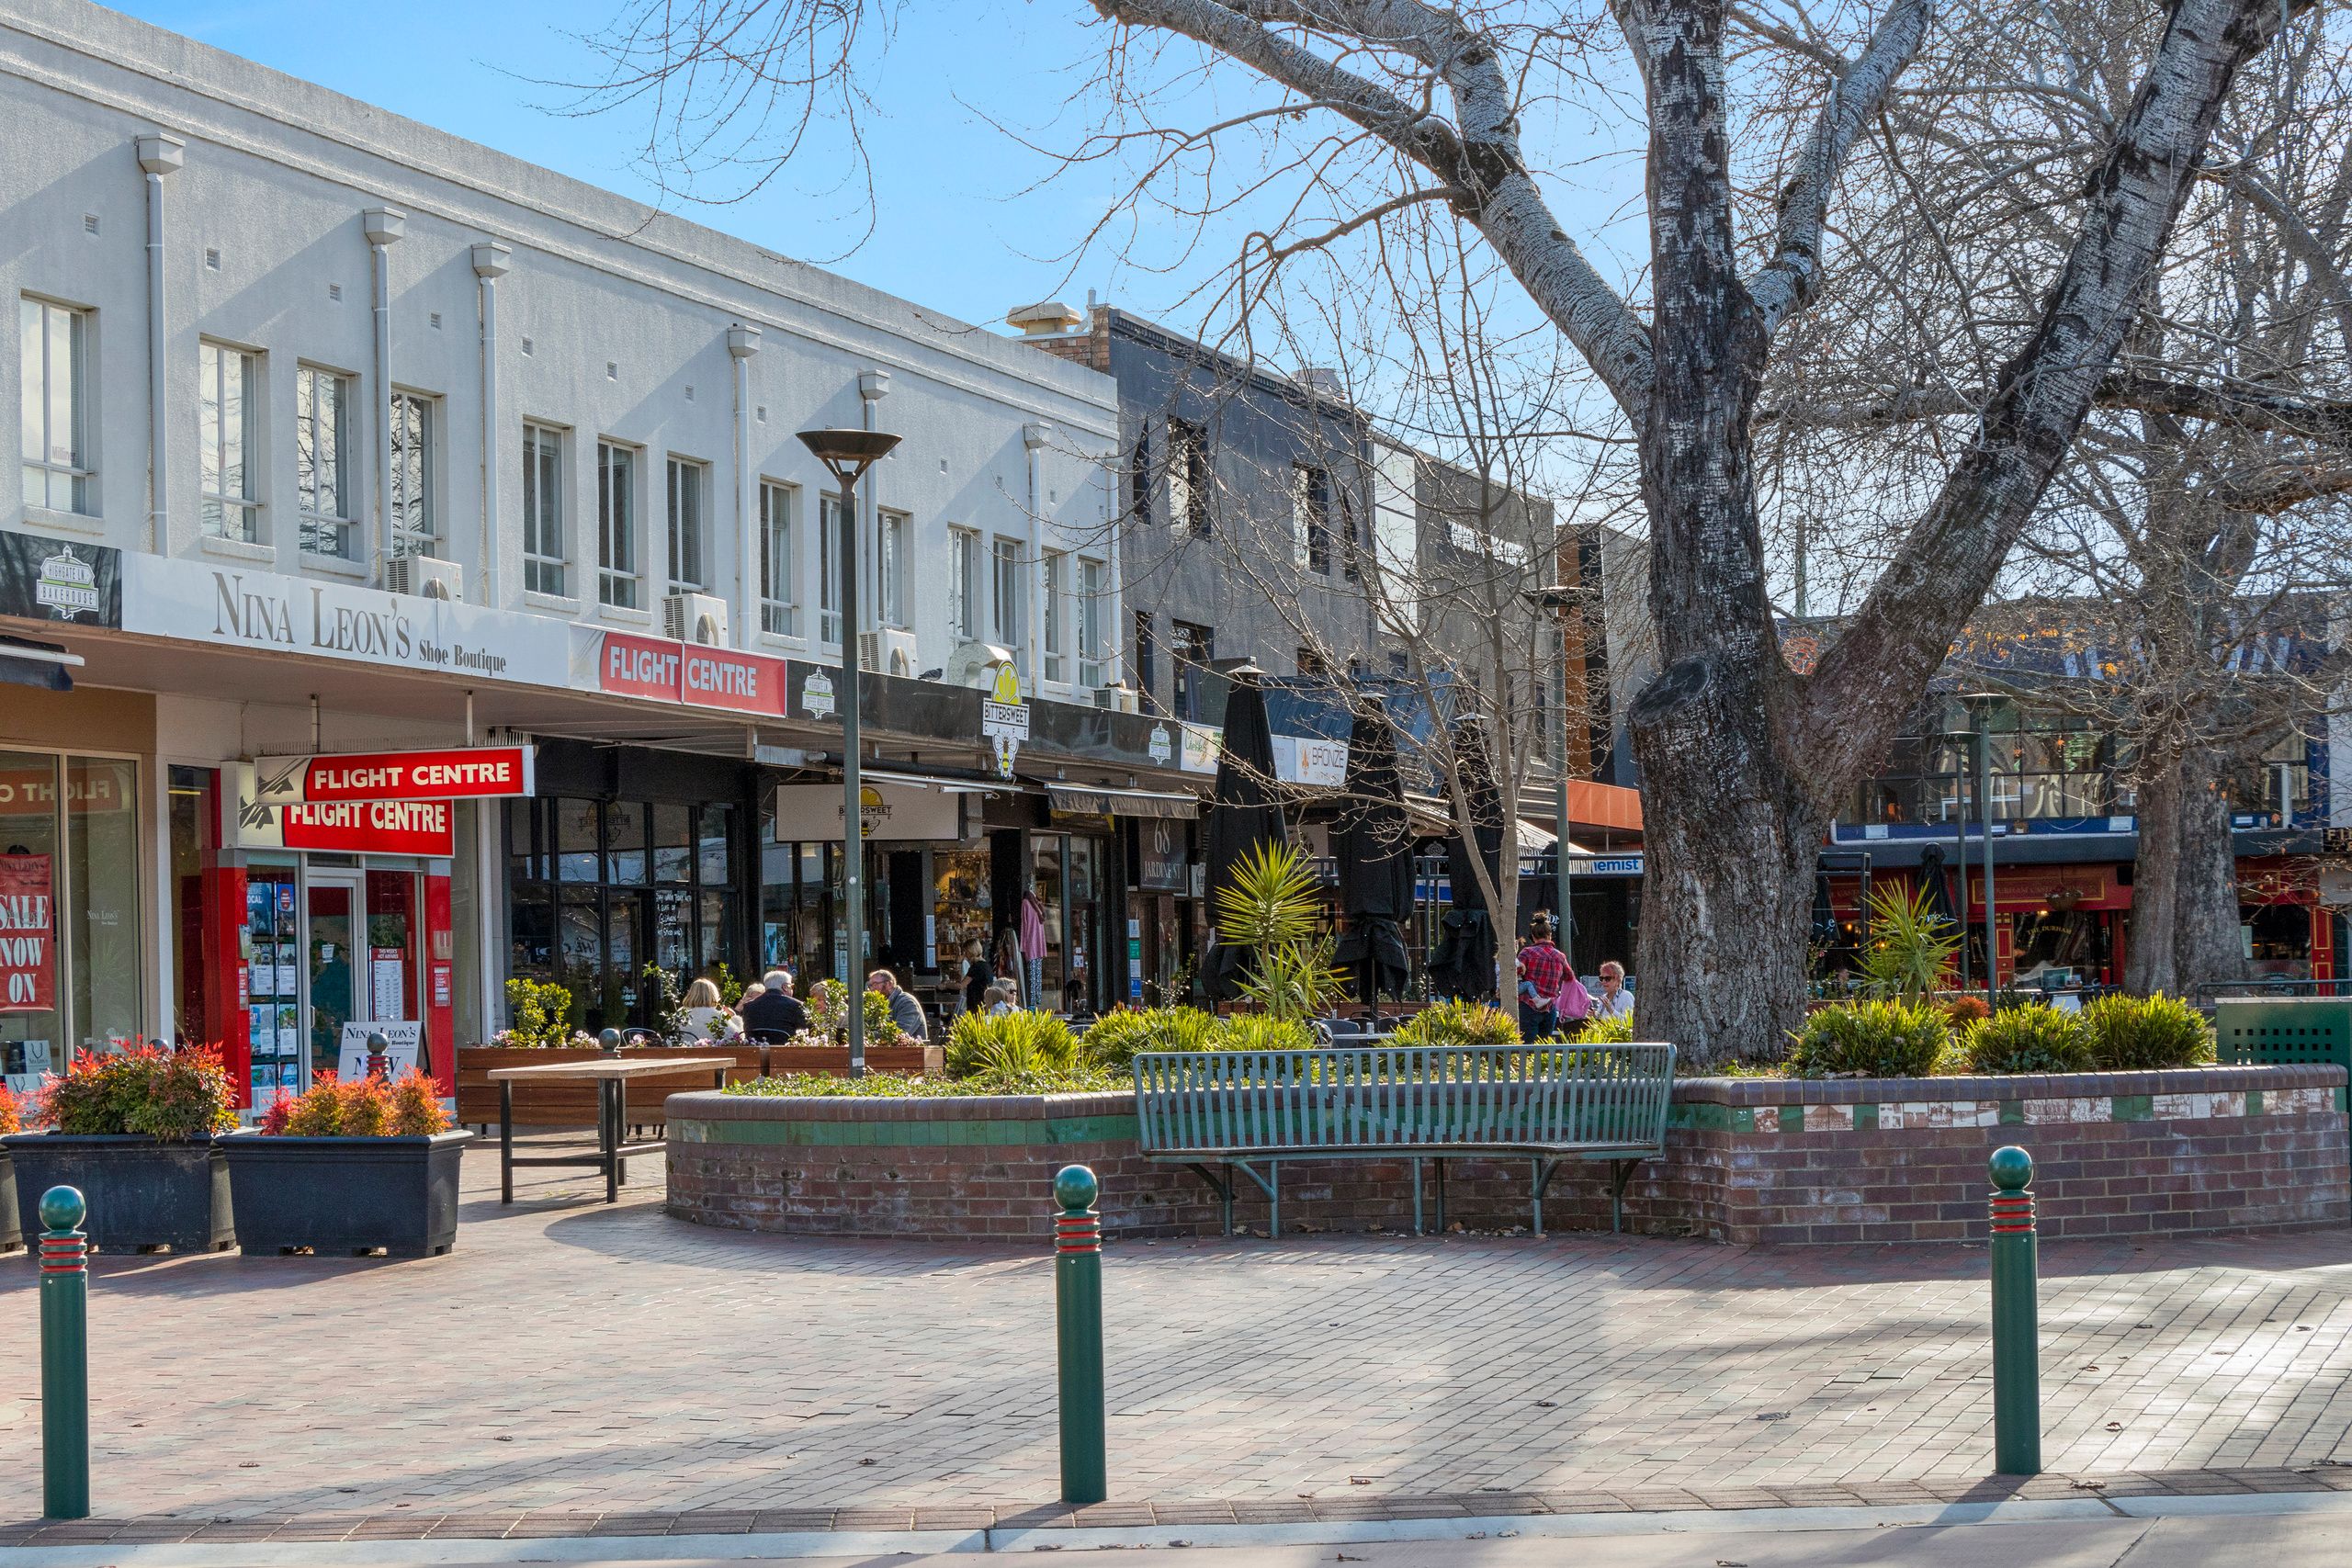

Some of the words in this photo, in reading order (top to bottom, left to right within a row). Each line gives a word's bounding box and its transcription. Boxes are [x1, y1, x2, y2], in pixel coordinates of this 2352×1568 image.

[48, 564, 75, 580] HIGHGATE
[42, 586, 93, 605] BAKEHOUSE
[212, 571, 295, 644] NINA
[310, 587, 411, 660] LEON'S
[419, 638, 448, 666] Shoe
[454, 644, 506, 676] Boutique
[610, 646, 679, 687] FLIGHT
[688, 658, 757, 698] CENTRE
[984, 704, 1028, 724] BITTERSWEET
[1312, 747, 1344, 769] BRONZE
[314, 766, 403, 789] FLIGHT
[412, 762, 511, 785] CENTRE
[290, 803, 364, 829] FLIGHT
[370, 802, 446, 833] CENTRE
[838, 807, 891, 815] BRSWEET
[1154, 818, 1170, 854] 68
[1145, 861, 1172, 880] JARDINE
[1172, 863, 1182, 879] ST
[246, 895, 263, 904] OCAL
[0, 895, 49, 930] SALE
[2041, 925, 2073, 935] DURHAM
[0, 937, 44, 967] NOW
[8, 972, 37, 1004] ON
[345, 1027, 372, 1040] NINA
[379, 1026, 416, 1039] EON'S
